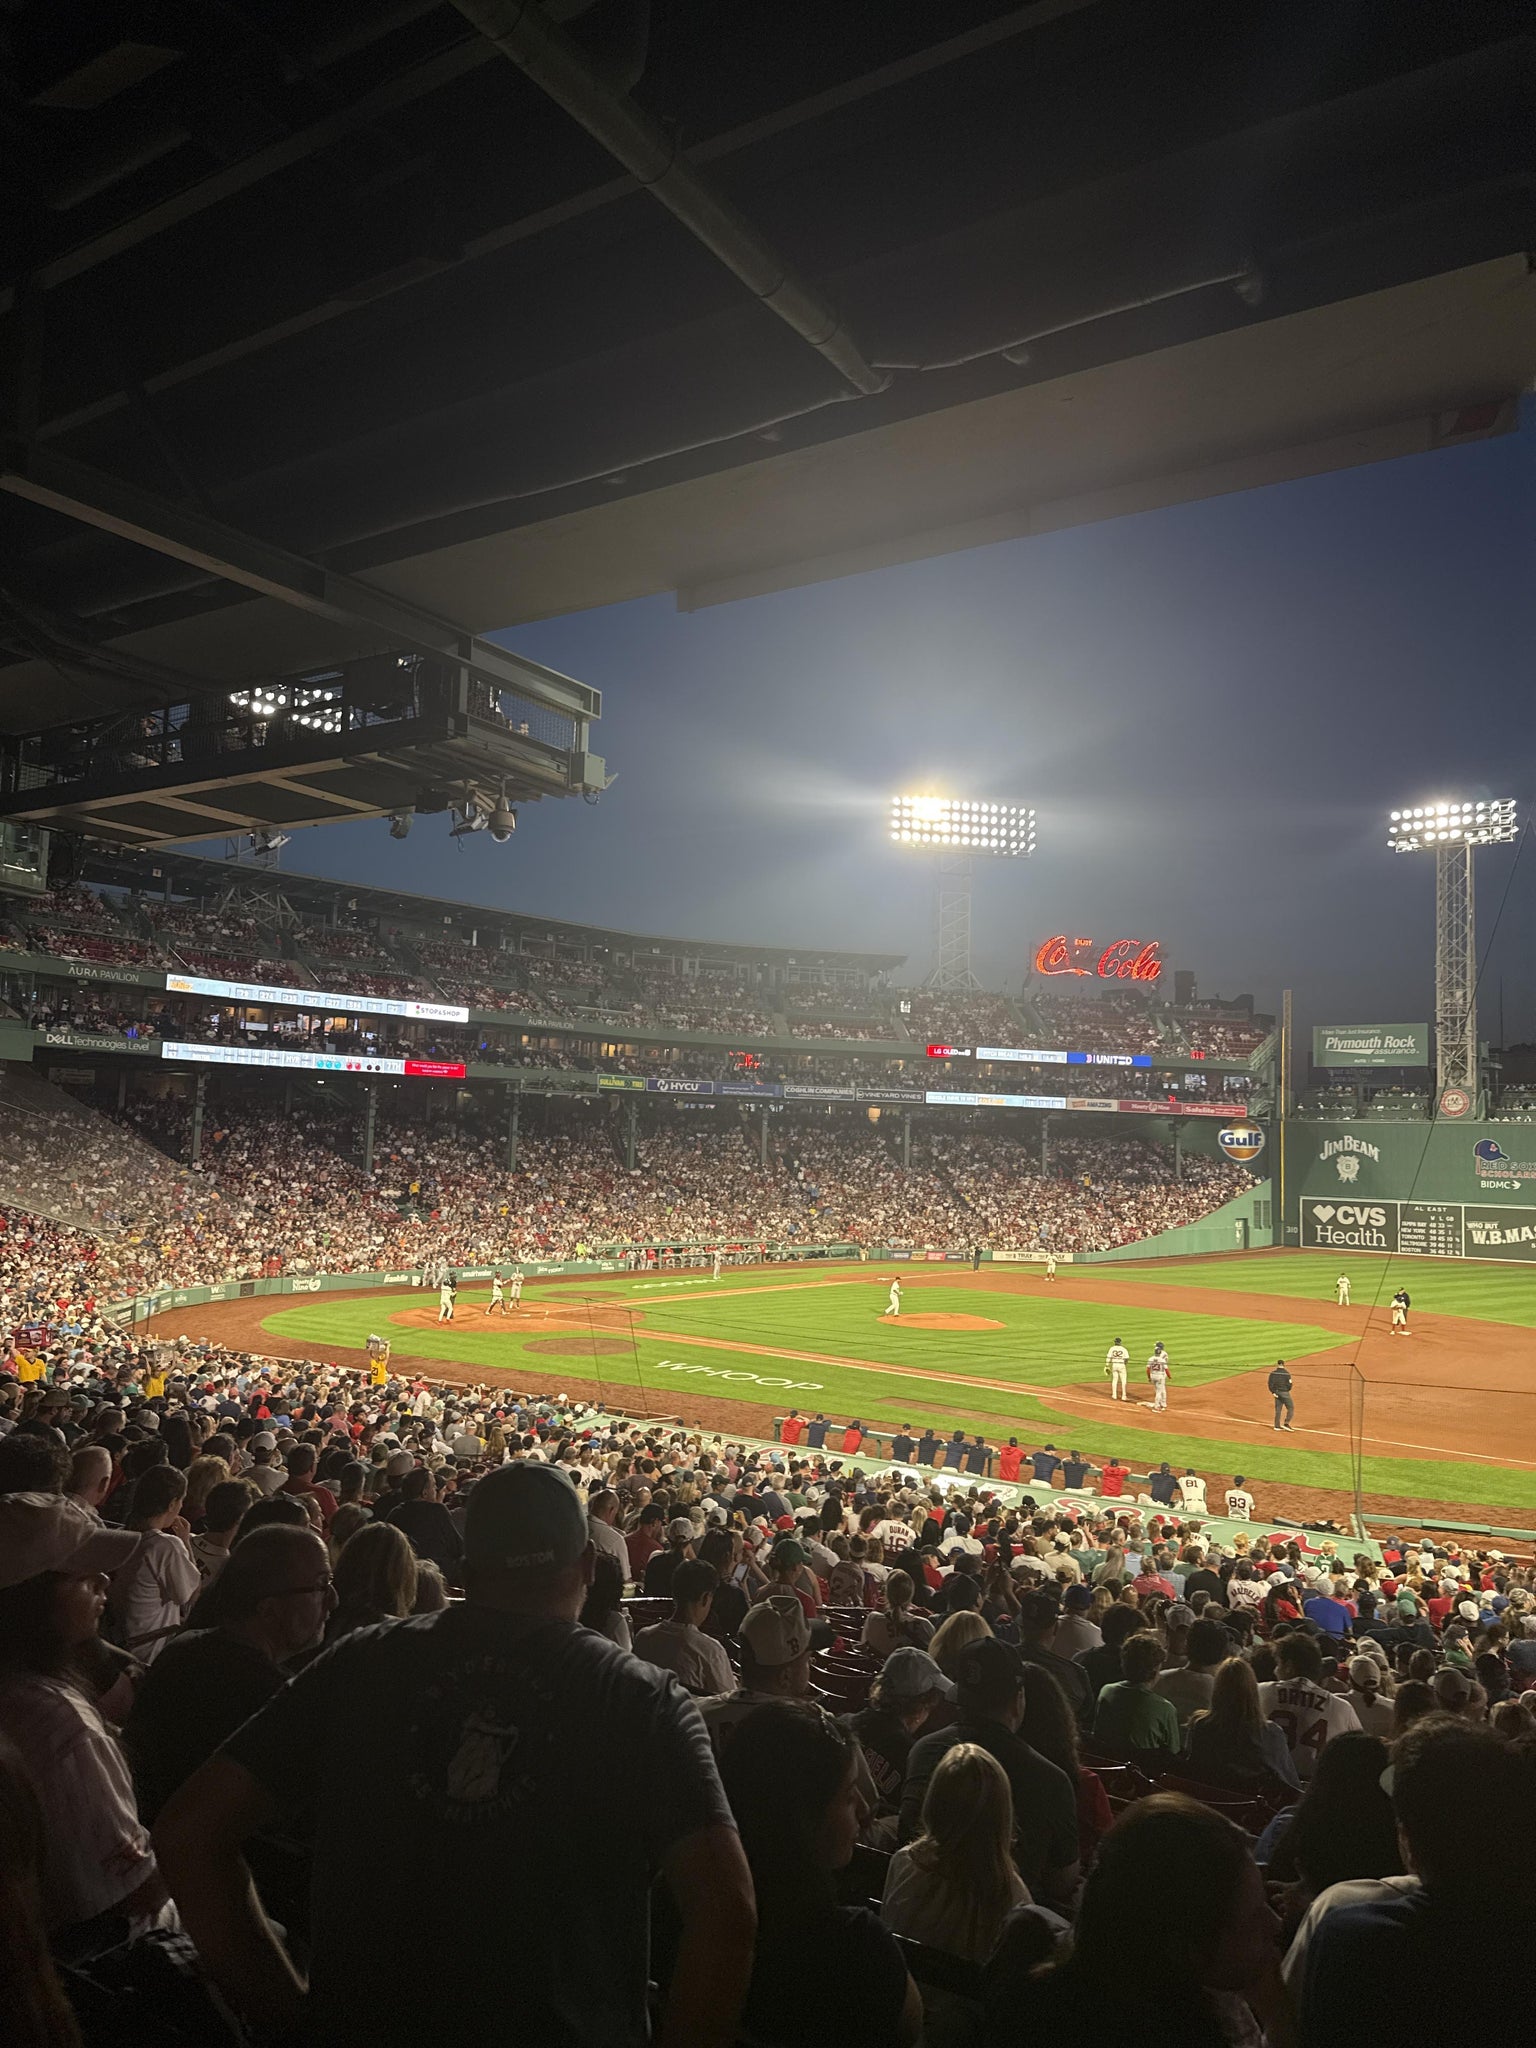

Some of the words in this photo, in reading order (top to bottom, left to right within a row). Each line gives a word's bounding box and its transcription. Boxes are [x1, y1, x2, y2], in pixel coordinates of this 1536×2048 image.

[68, 966, 98, 978] AURA
[99, 970, 140, 983] PAVILION
[46, 1034, 73, 1046] DELL
[72, 1036, 127, 1051] Technologies
[128, 1041, 150, 1051] Level
[1325, 1036, 1381, 1051] Plymouth
[1383, 1035, 1417, 1049] Rock
[1096, 1055, 1133, 1066] UNITED
[670, 1082, 700, 1092] HYCU
[865, 1091, 900, 1100] VINEYARD
[901, 1093, 922, 1101] VINES
[1185, 1106, 1216, 1114] Safelite
[1220, 1132, 1262, 1146] Gulf
[1320, 1140, 1344, 1161] JIM
[1343, 1135, 1381, 1162] BEAM
[1481, 1161, 1508, 1170] RED
[1481, 1180, 1511, 1190] BIDMC
[1336, 1205, 1387, 1227] CVS
[1286, 1226, 1299, 1234] 310
[1466, 1222, 1483, 1230] WHO
[1315, 1225, 1388, 1247] Health
[1401, 1240, 1429, 1248] BALTIMORE
[653, 1360, 824, 1391] WHOOP
[1185, 1479, 1198, 1489] 81
[1230, 1496, 1246, 1509] 83
[890, 1525, 909, 1537] DURAN
[1278, 1687, 1328, 1712] ORTIZ
